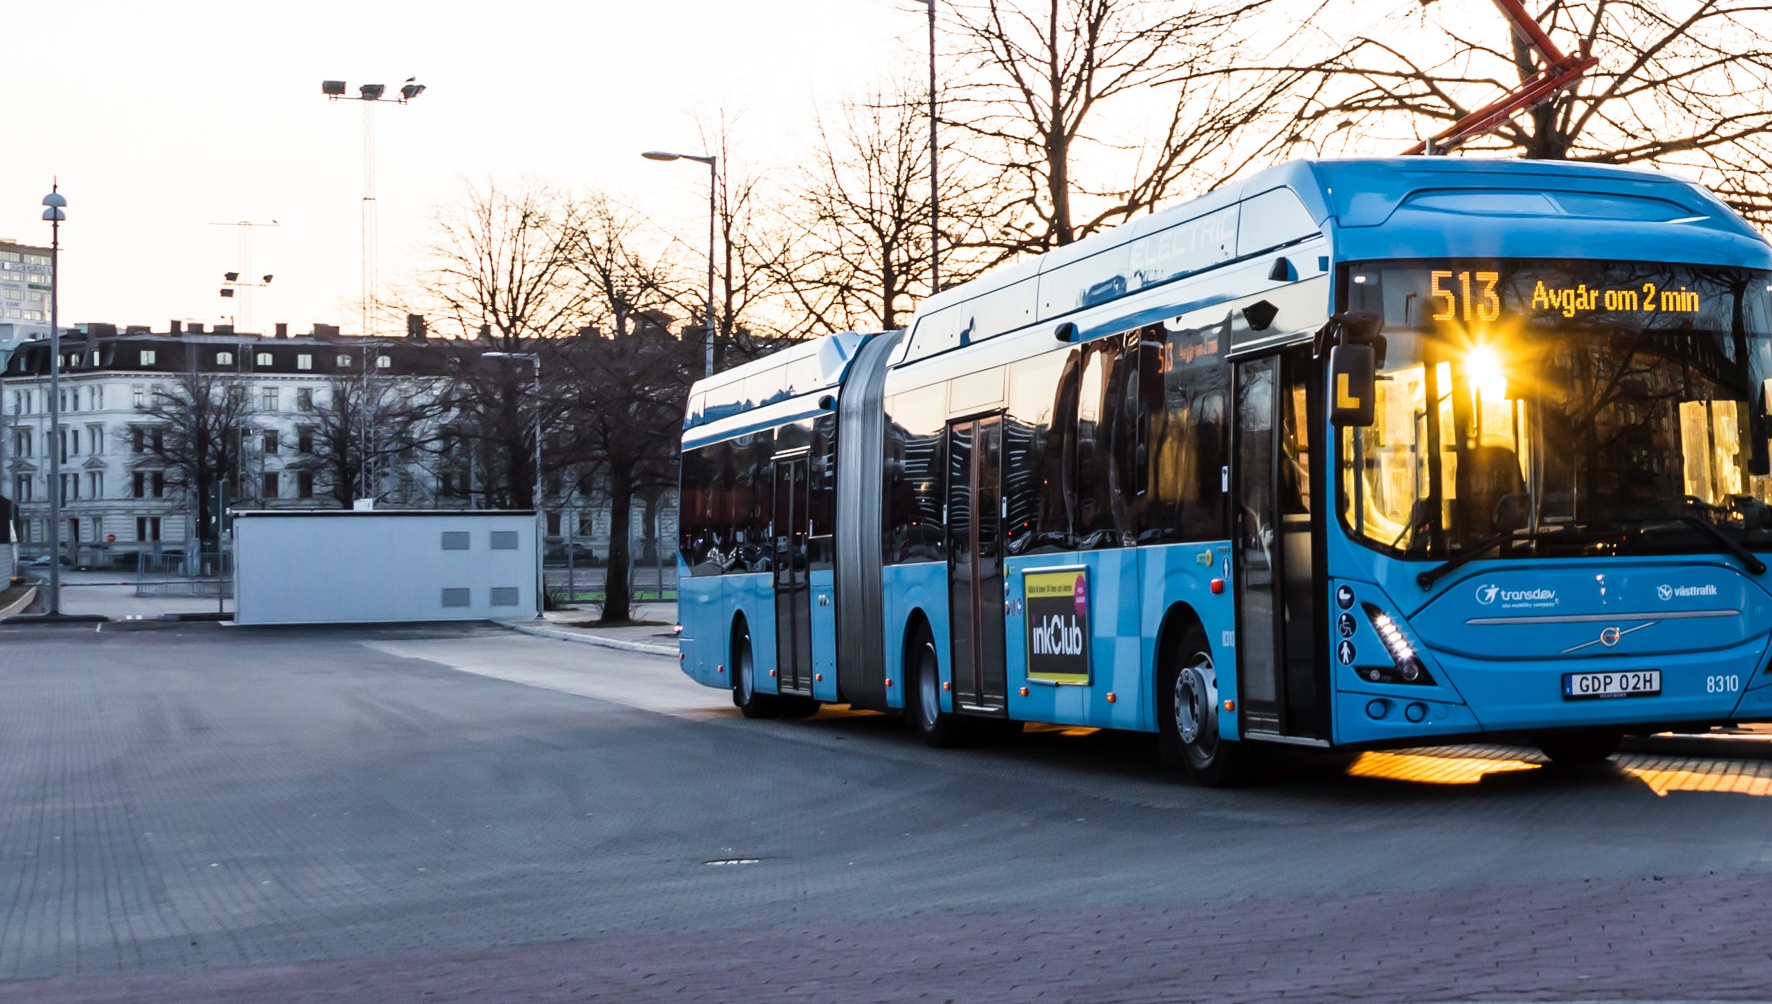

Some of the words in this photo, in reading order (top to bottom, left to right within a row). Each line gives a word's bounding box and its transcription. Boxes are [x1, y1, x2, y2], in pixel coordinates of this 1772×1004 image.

[1130, 208, 1237, 270] ELECTRIC
[1431, 271, 1500, 321] 513
[1532, 281, 1599, 318] Avgår
[1604, 288, 1638, 311] om
[1642, 283, 1656, 312] 2
[1661, 286, 1699, 312] min
[1158, 341, 1174, 373] 513
[1500, 587, 1556, 601] transdev
[1674, 584, 1717, 597] västtrafik
[1032, 614, 1083, 656] inkClub
[1579, 675, 1613, 693] GDP
[1619, 673, 1653, 690] 02H
[1706, 675, 1739, 693] 8310
